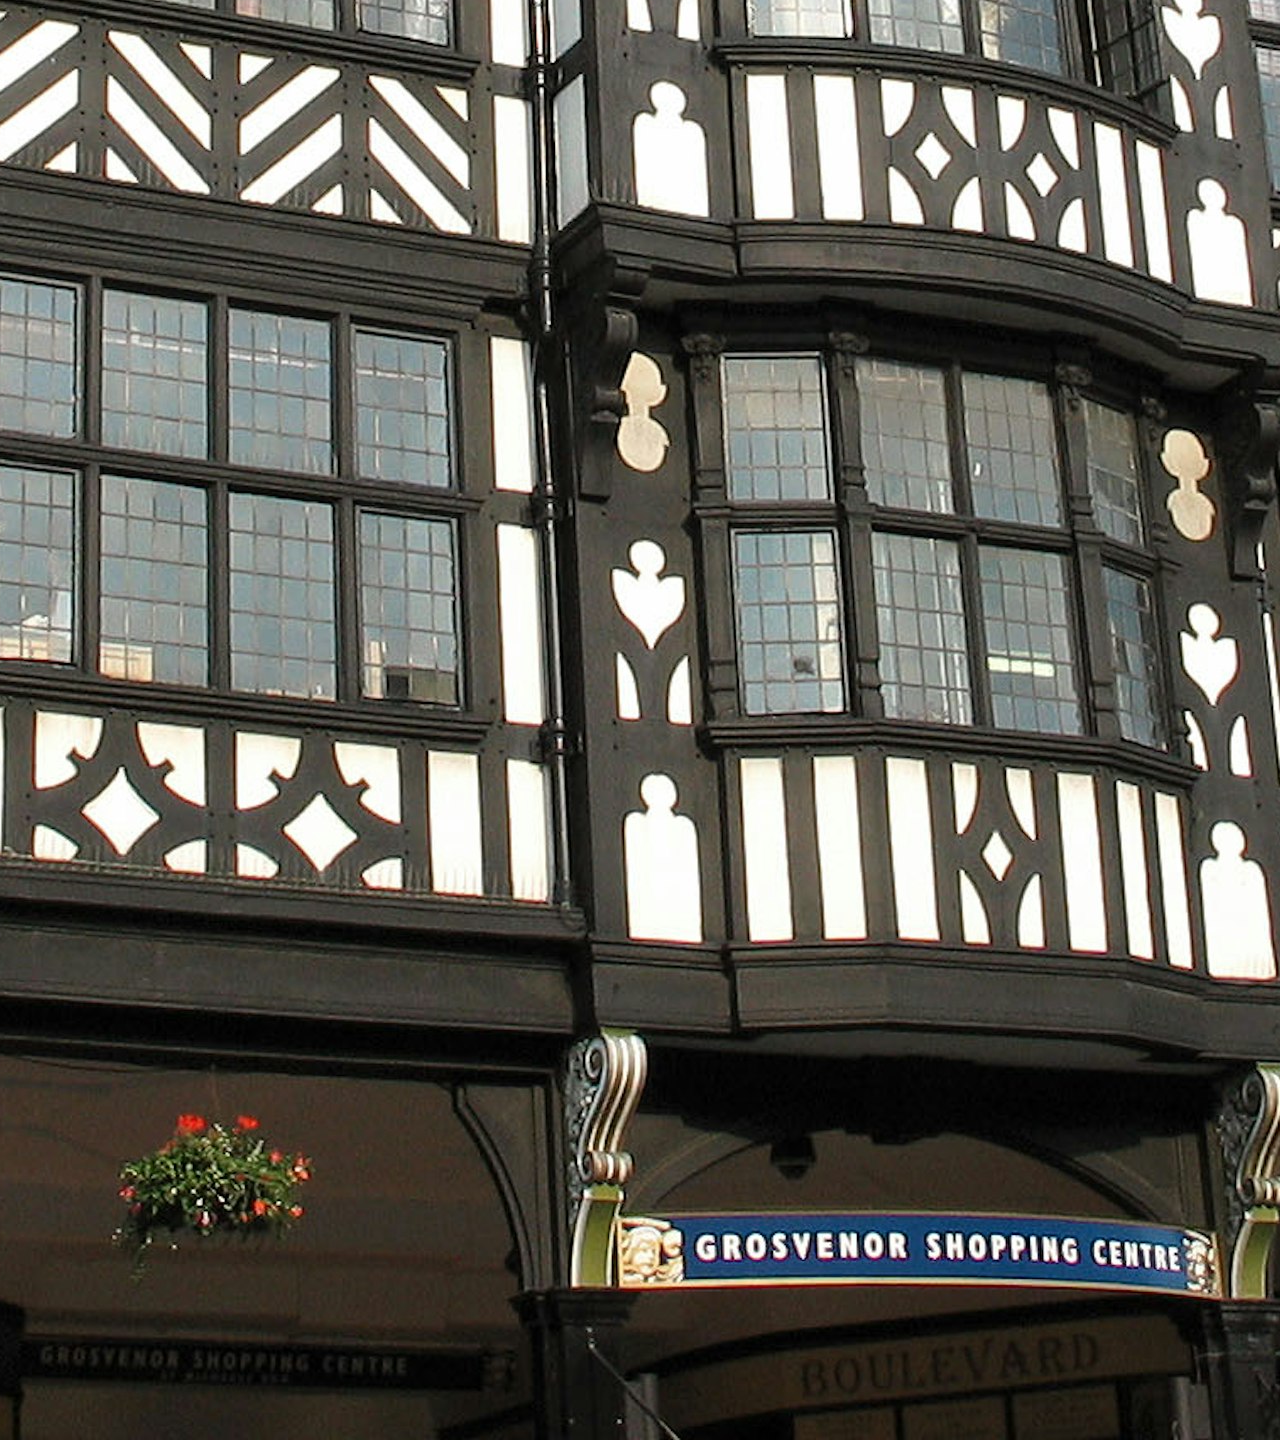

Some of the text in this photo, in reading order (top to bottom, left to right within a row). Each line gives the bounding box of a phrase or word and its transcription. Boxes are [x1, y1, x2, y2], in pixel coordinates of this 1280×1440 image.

[694, 1232, 1182, 1272] GROSVENOR SHOPPING CENTRE
[39, 1345, 409, 1376] GROSVENOR SHOPPING CENTRE
[801, 1332, 1099, 1397] BOULEVARD
